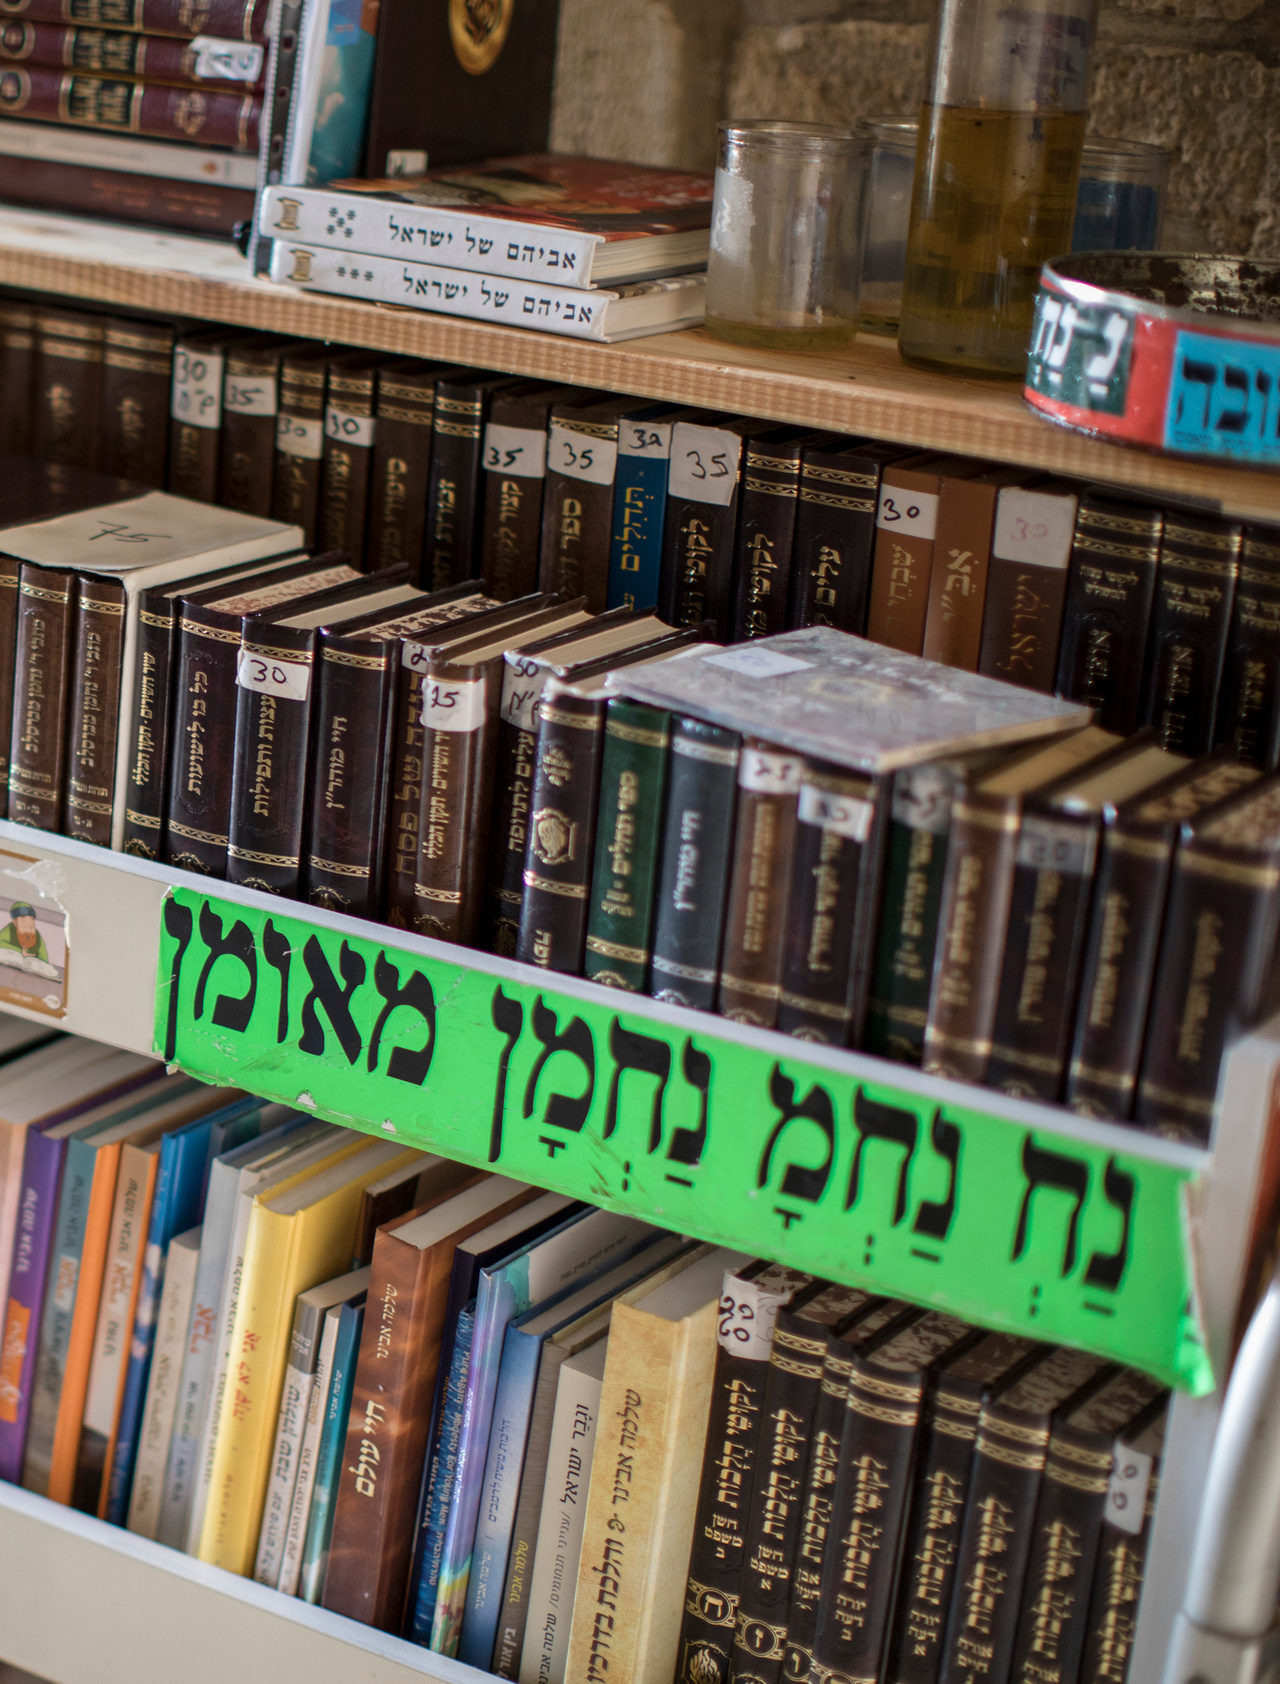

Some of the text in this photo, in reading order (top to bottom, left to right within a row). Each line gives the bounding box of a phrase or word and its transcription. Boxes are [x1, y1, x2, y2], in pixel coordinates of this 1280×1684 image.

[388, 216, 577, 271] אביהם של ישראל
[402, 267, 594, 324] אביהם של ישראל
[488, 447, 523, 467] 35
[564, 443, 593, 469] 35
[686, 451, 729, 479] 35
[560, 498, 581, 550] ספר
[883, 498, 920, 521] 30
[90, 521, 173, 543] 75
[680, 519, 714, 583] לקוטי
[746, 534, 778, 603] לקוטי
[810, 546, 841, 606] עלים
[31, 619, 45, 650] כתבי
[87, 632, 101, 663] כתבי
[28, 667, 44, 698] נחמן
[251, 658, 287, 685] 30
[83, 682, 101, 711] נחמן
[21, 700, 40, 753] מברסלב
[132, 652, 155, 786] שיר השירים תקון הכללי
[187, 671, 207, 795] כל בו לישועות
[331, 716, 347, 743] חיי
[76, 714, 97, 767] מברסלב
[249, 695, 276, 816] עצות ותפילות
[422, 745, 450, 859] השירים תקון הכללי
[508, 731, 534, 852] עלים לתרופה
[394, 755, 420, 875] של פסח
[680, 810, 700, 841] חיי
[163, 894, 436, 1086] מאומן
[16, 1188, 38, 1272] שלמה אבינר
[118, 1179, 138, 1253] שלמה אבינר
[225, 1256, 244, 1335] שלמה אבינר
[376, 1283, 397, 1359] שלמה אבינר
[460, 1351, 470, 1374] Pure
[454, 1376, 468, 1403] Again
[279, 1384, 299, 1438] שולחן
[348, 1400, 386, 1497] חיי עולם
[447, 1412, 462, 1453] Modesty
[497, 1419, 510, 1452] הלכות
[275, 1440, 292, 1482] שבת
[494, 1454, 506, 1481] משיח
[560, 1448, 582, 1505] ישראל
[440, 1473, 454, 1502] Young
[439, 1504, 448, 1525] Men
[712, 1514, 738, 1530] חשן
[586, 1388, 641, 1683] שלמה אבינר והלכת בדרכיו
[704, 1526, 743, 1547] משפט
[758, 1545, 783, 1561] חשן
[477, 1551, 491, 1582] שלמה
[751, 1557, 788, 1579] משפט
[474, 1583, 486, 1610] אבינר
[500, 1541, 529, 1667] שלמה אבינר בין אור
[541, 1614, 557, 1652] שלמה
